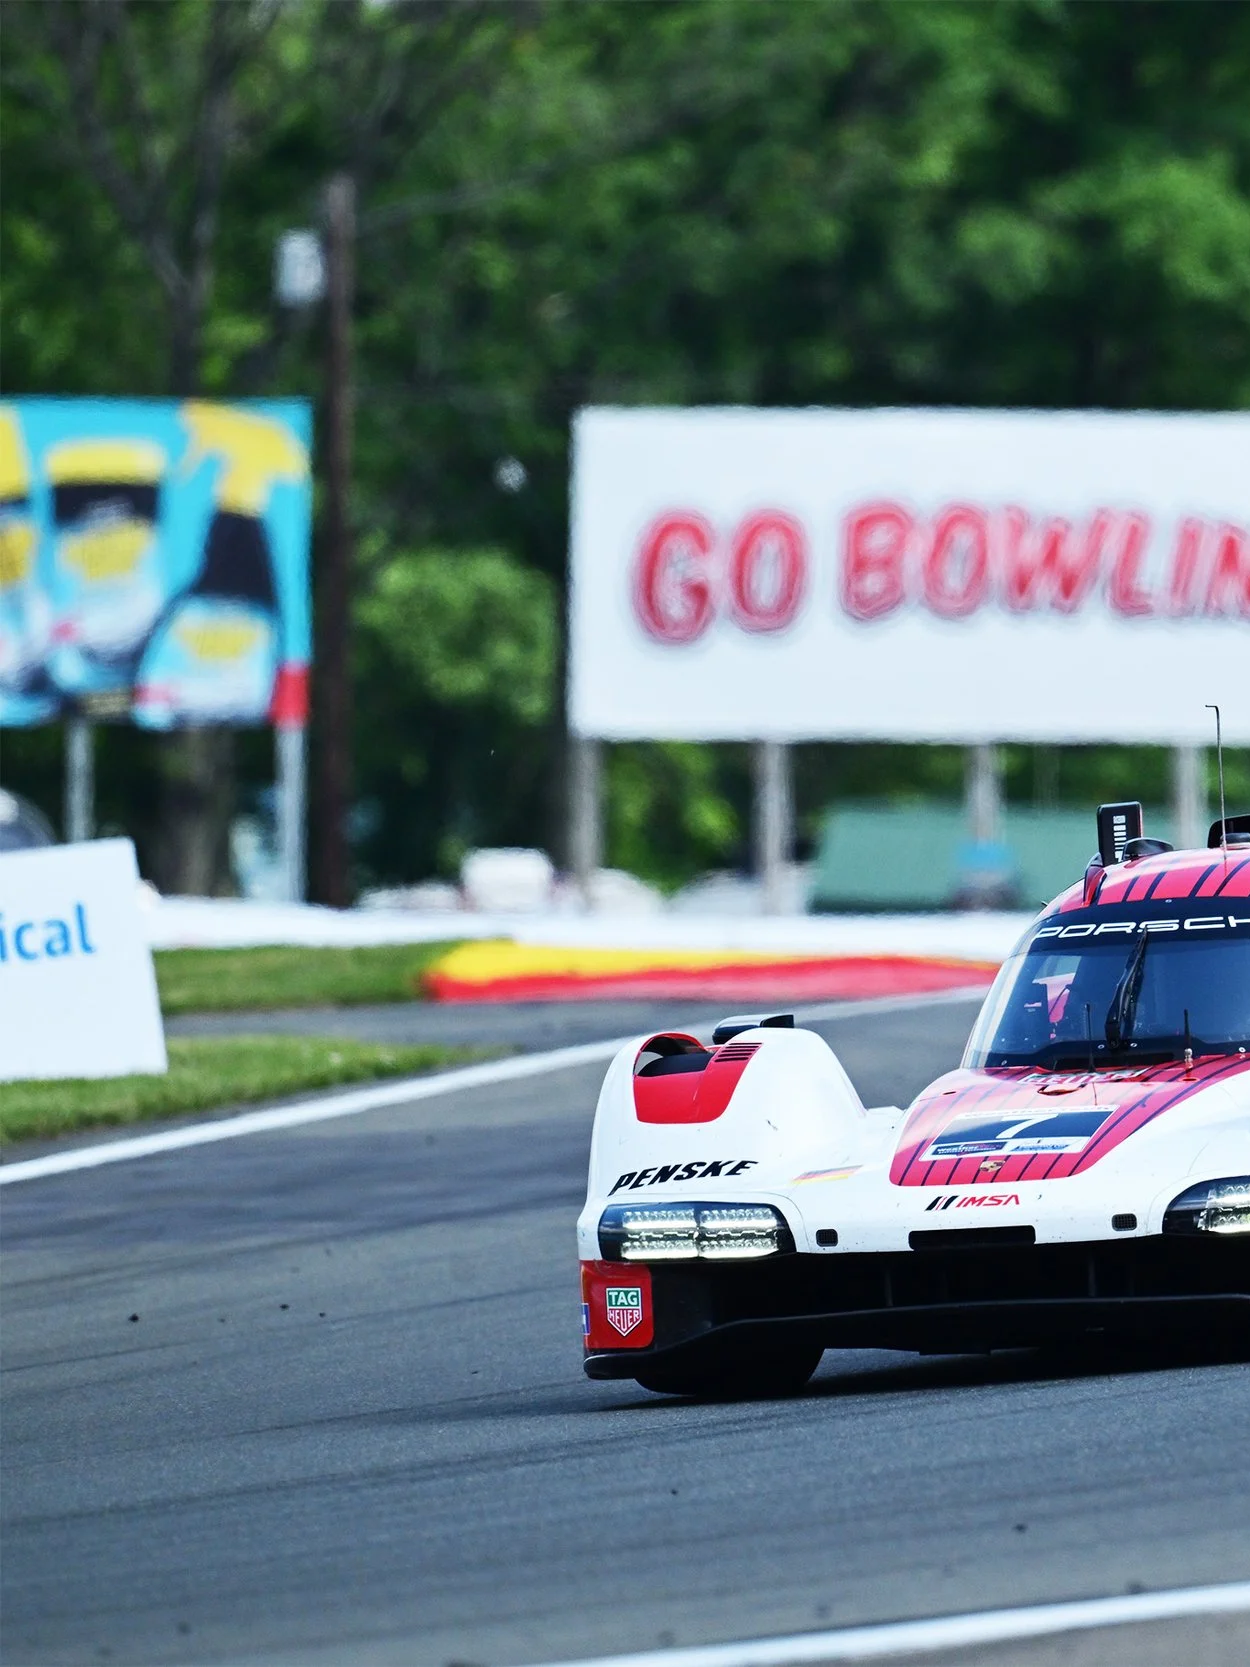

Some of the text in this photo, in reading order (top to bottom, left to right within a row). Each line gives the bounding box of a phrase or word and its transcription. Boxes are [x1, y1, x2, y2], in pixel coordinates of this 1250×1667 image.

[630, 507, 808, 646] GO
[995, 1113, 1059, 1139] 7
[606, 1160, 760, 1198] PENSKE
[955, 1194, 1021, 1208] IMSA
[608, 1291, 638, 1306] TAG
[608, 1309, 641, 1333] HEUER
